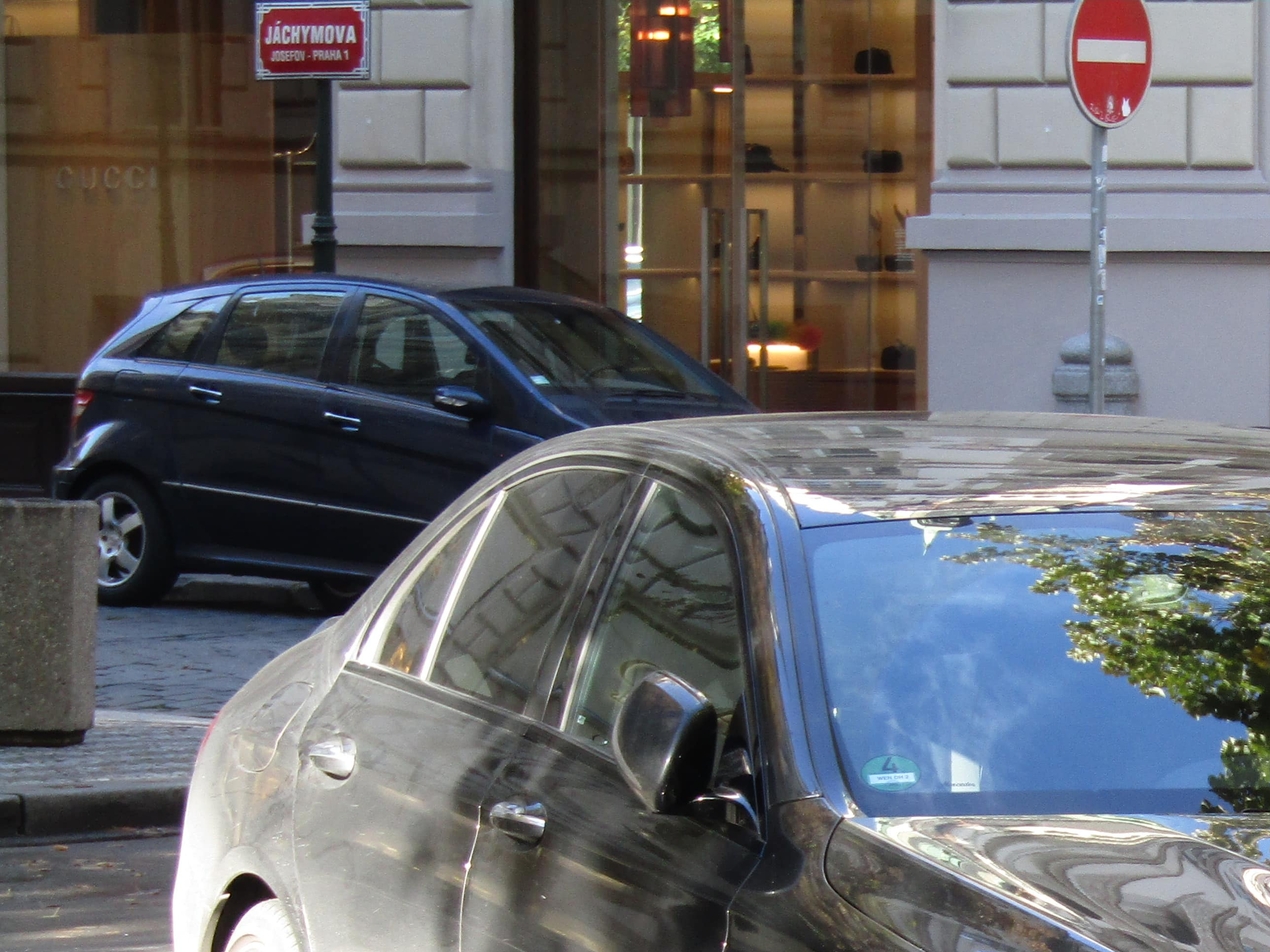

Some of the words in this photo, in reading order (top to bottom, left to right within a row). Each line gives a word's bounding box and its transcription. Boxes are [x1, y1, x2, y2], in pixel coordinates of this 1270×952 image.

[265, 20, 357, 45] JÁCHYMOVA
[271, 50, 305, 62] JOSEFOV
[312, 49, 342, 61] PRAHA
[343, 49, 349, 60] 1
[56, 165, 158, 190] GUCCI
[882, 756, 898, 772] 4
